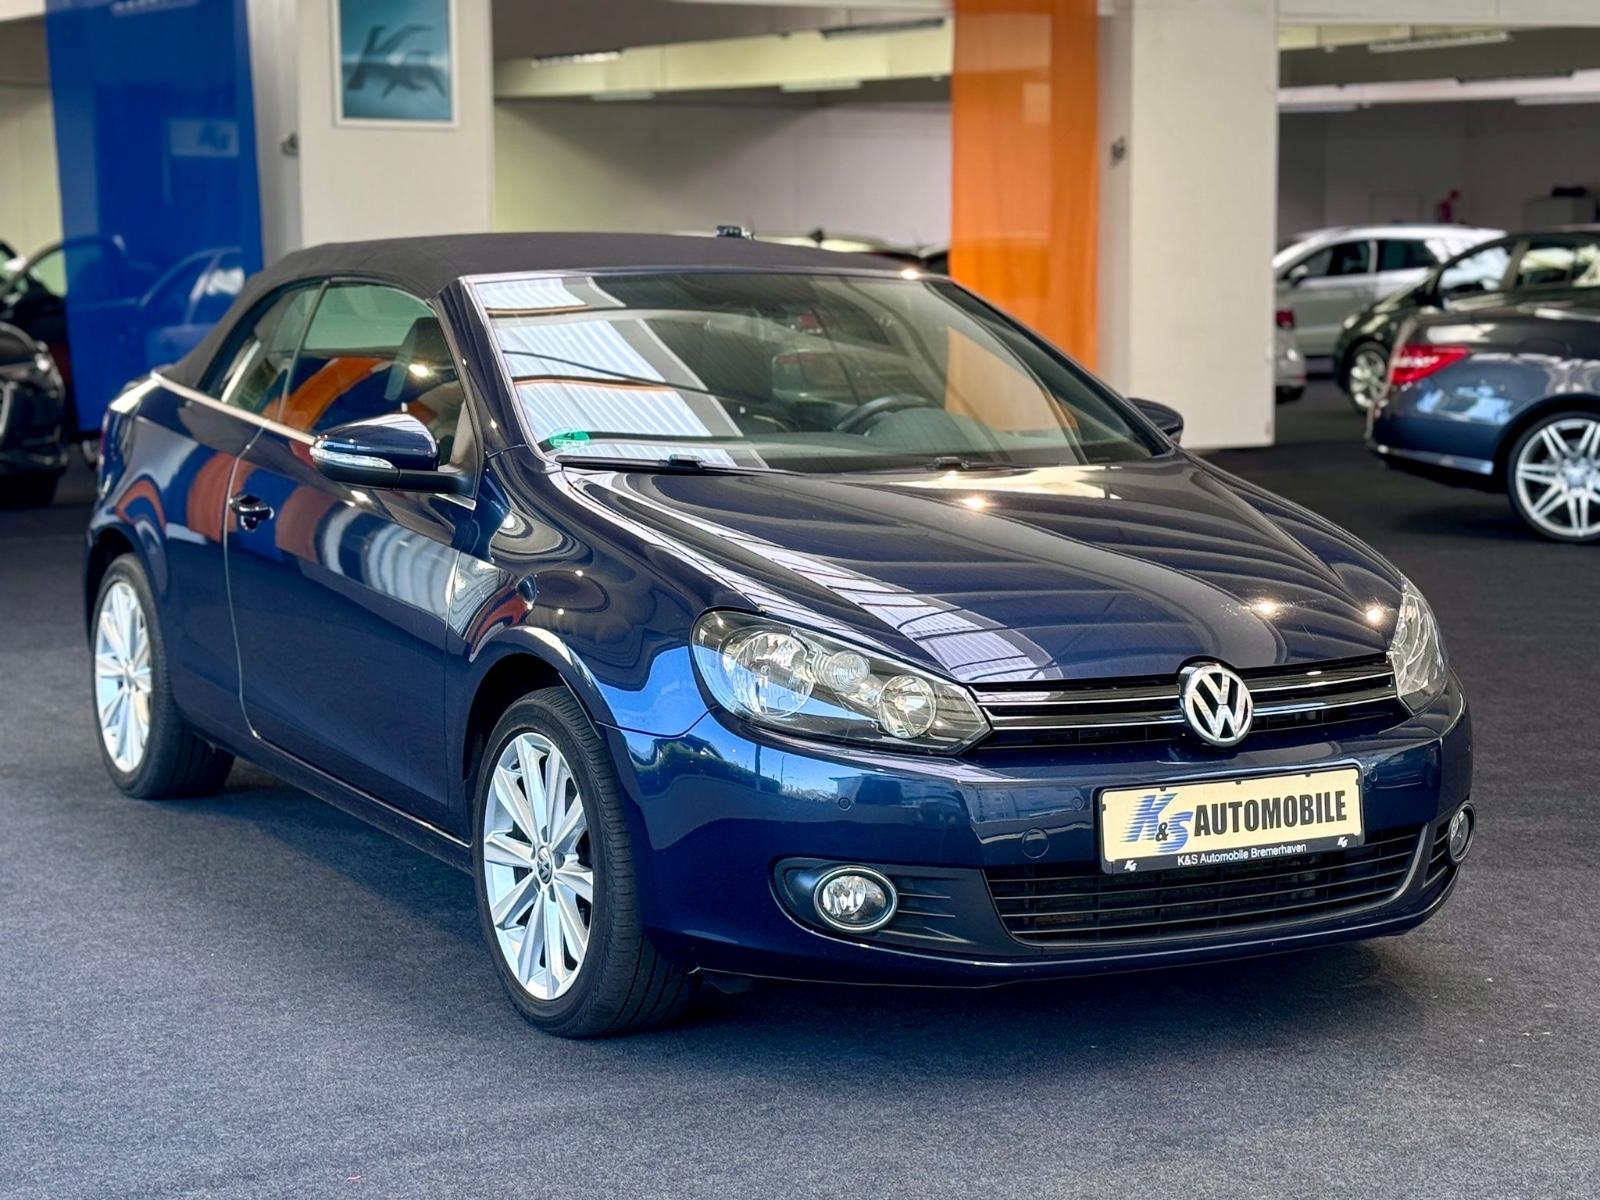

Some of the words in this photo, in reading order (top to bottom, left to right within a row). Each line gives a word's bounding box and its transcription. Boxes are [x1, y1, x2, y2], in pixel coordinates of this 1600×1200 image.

[1187, 667, 1251, 741] VW
[1194, 790, 1347, 836] AUTOMOBILE
[1177, 854, 1198, 866] K&S
[1200, 849, 1249, 864] Automobile
[1251, 844, 1307, 858] Bremerhaven
